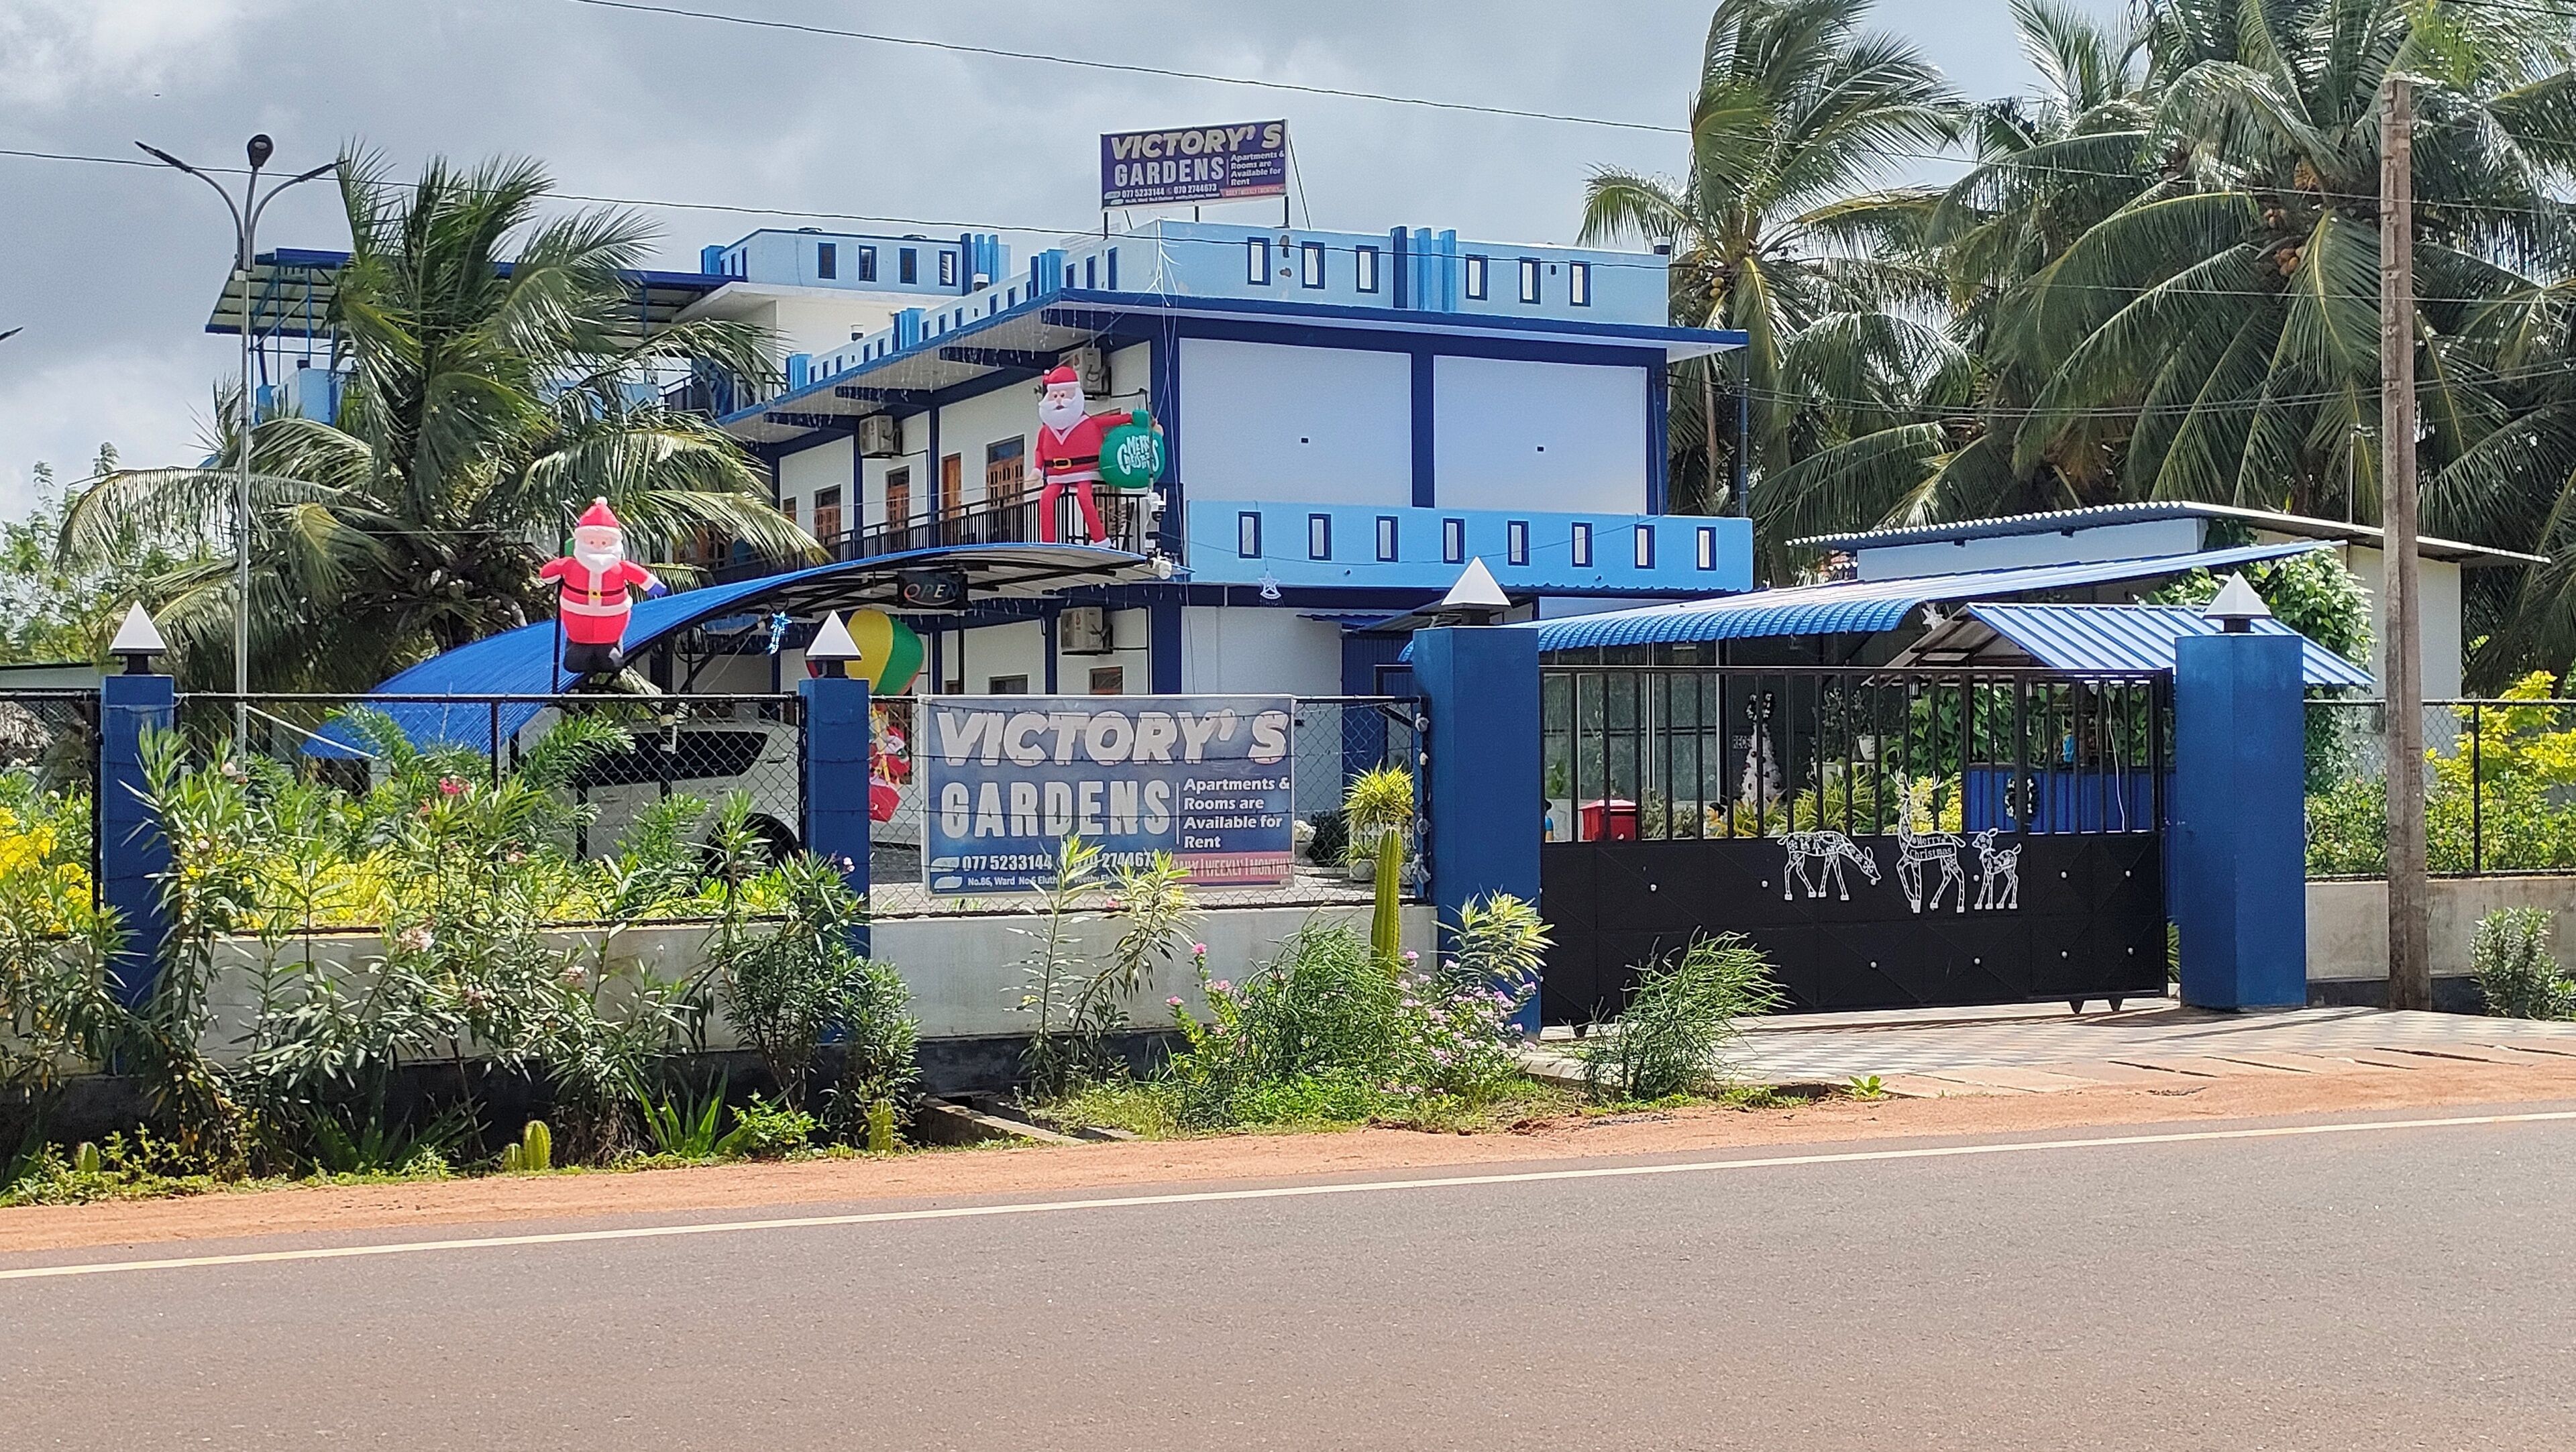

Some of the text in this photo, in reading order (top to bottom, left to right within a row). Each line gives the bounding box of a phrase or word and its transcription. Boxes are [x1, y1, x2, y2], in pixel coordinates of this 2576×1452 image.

[1230, 152, 1278, 162] Apartments
[1114, 156, 1225, 187] GARDENS
[1231, 162, 1257, 170] Rooms
[1230, 168, 1268, 178] Available
[1231, 178, 1250, 186] Rent
[1122, 190, 1134, 198] 077
[904, 581, 959, 600] OPEN
[1183, 777, 1290, 795] Apartments &
[941, 779, 1171, 839] GARDENS
[1184, 797, 1265, 810] Rooms are
[1183, 814, 1283, 830] Available for
[1184, 836, 1222, 848] Rent
[1917, 836, 1941, 846] Merry
[1909, 847, 1952, 859] Christmas
[962, 856, 987, 871] 077
[989, 854, 1053, 871] 5233144
[1205, 859, 1243, 877] WEEKLY
[1250, 858, 1293, 876] MONTHLY
[994, 876, 1016, 885] Ward
